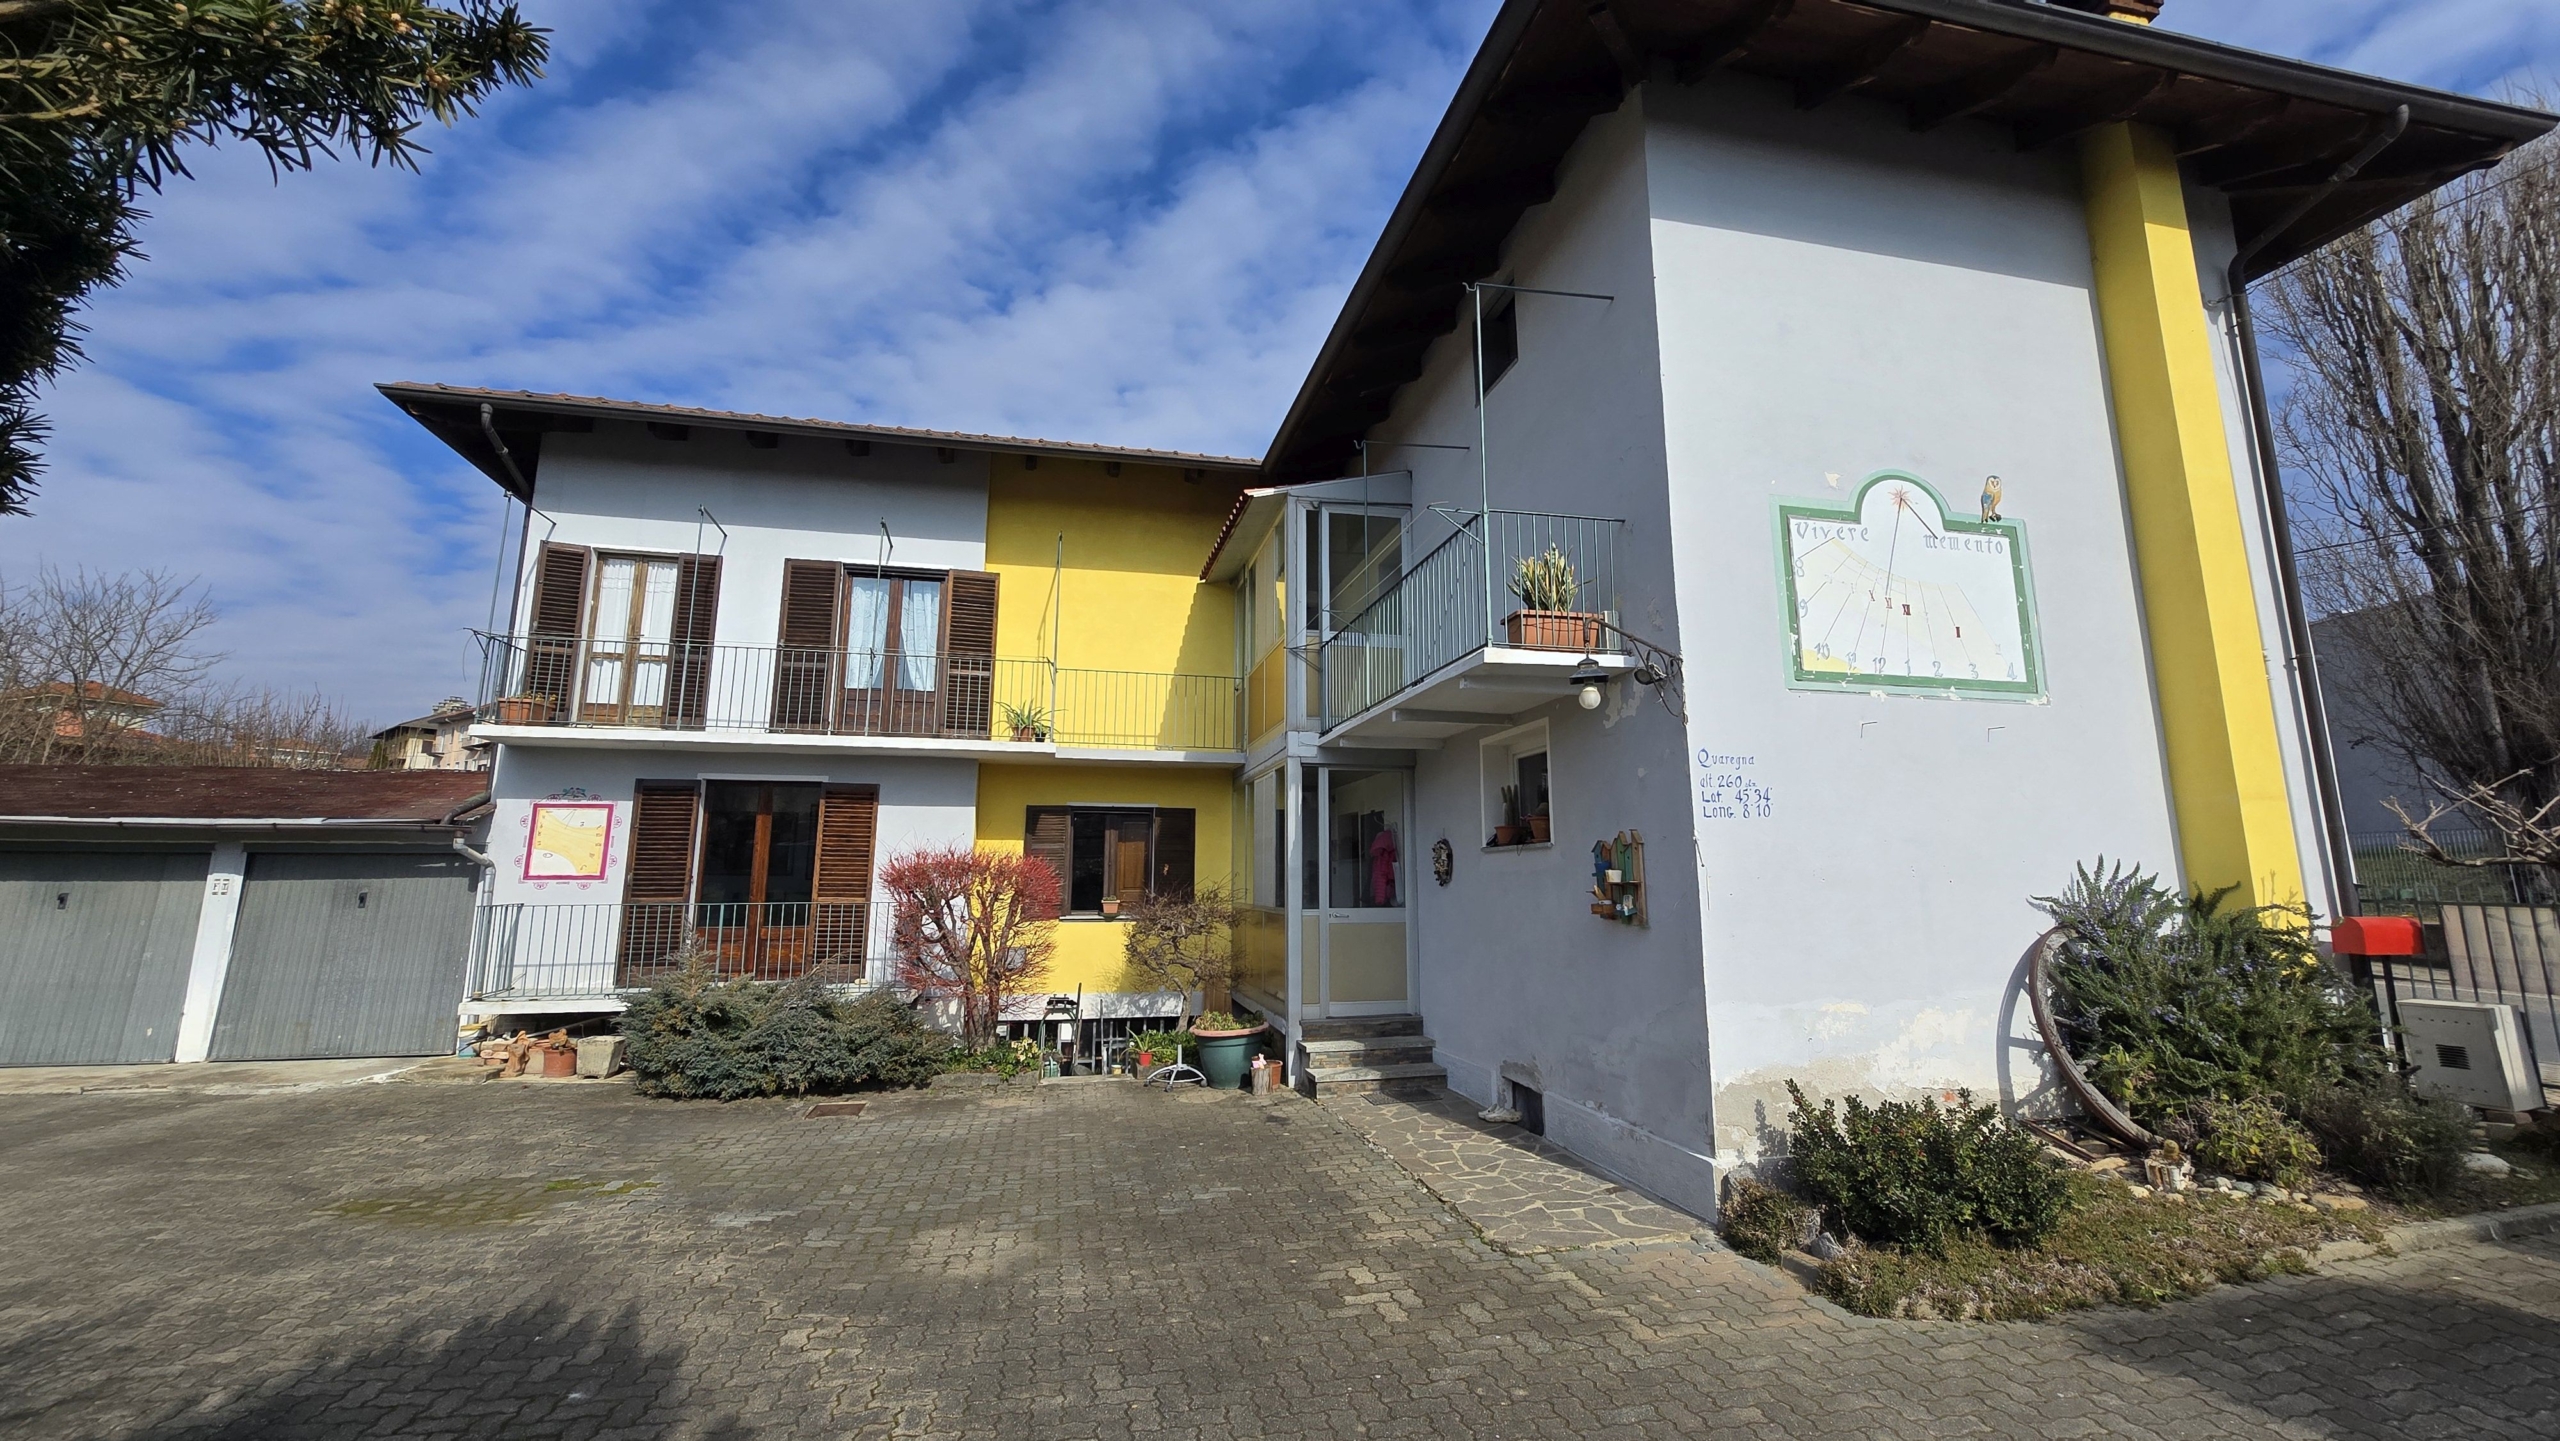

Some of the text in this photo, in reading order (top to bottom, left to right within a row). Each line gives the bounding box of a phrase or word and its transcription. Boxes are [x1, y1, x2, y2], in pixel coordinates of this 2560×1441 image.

[1795, 522, 2003, 554] Vivere memento
[1873, 657, 1887, 674] 12
[1932, 661, 1944, 677] 2
[1968, 663, 1979, 680] 3
[2006, 662, 2018, 680] 4
[1697, 748, 1755, 771] Quaregna
[1717, 774, 1743, 788] 260
